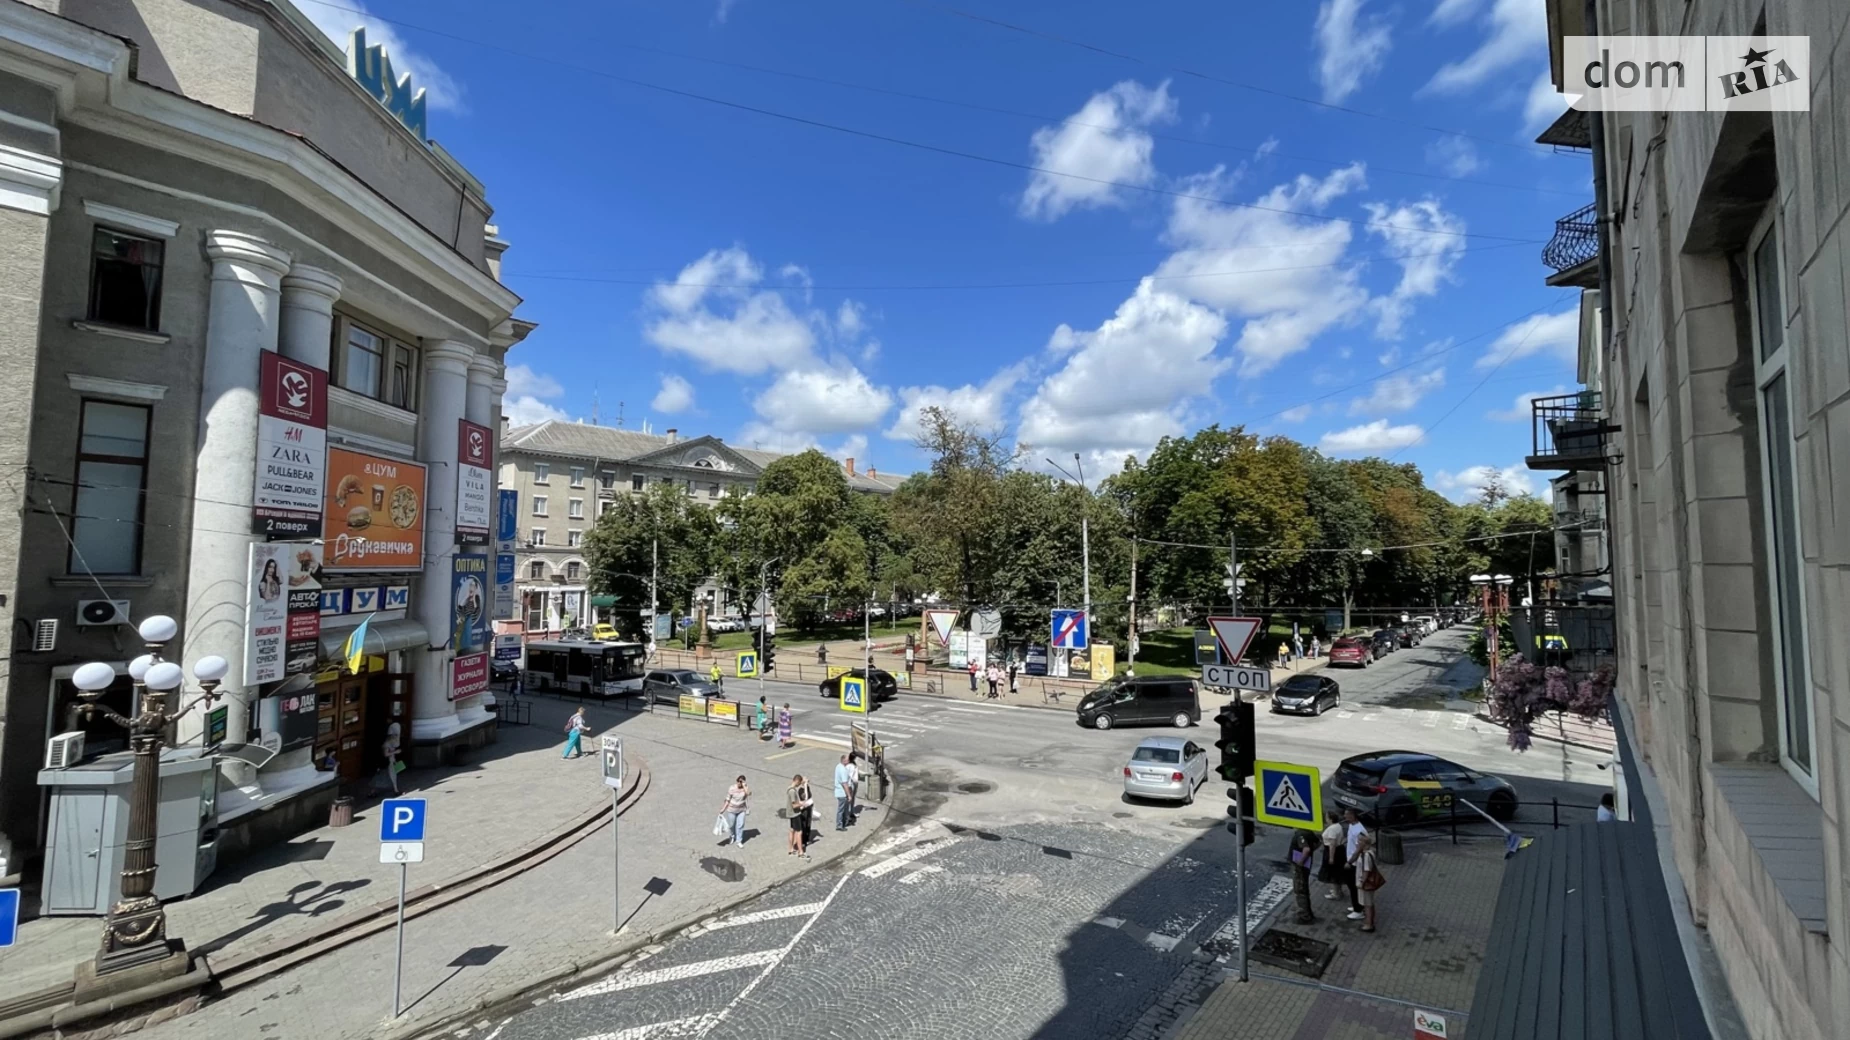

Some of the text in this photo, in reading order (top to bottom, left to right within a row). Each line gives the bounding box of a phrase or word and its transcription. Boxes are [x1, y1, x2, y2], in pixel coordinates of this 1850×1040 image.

[272, 445, 311, 465] ZARA
[267, 464, 314, 481] PULL&BEAR
[465, 480, 484, 491] VILA
[266, 519, 309, 533] 2 поверх
[455, 557, 486, 573] ОПТИКА
[289, 591, 320, 601] АВТО
[320, 588, 408, 614] ЦУМ
[288, 600, 320, 609] ПРОКАТ
[460, 656, 481, 668] ГАЗЕТИ
[457, 669, 484, 682] ЖУРНАЛИ
[1207, 667, 1264, 689] СТОП
[603, 737, 620, 749] ЗОНА
[393, 806, 414, 834] P
